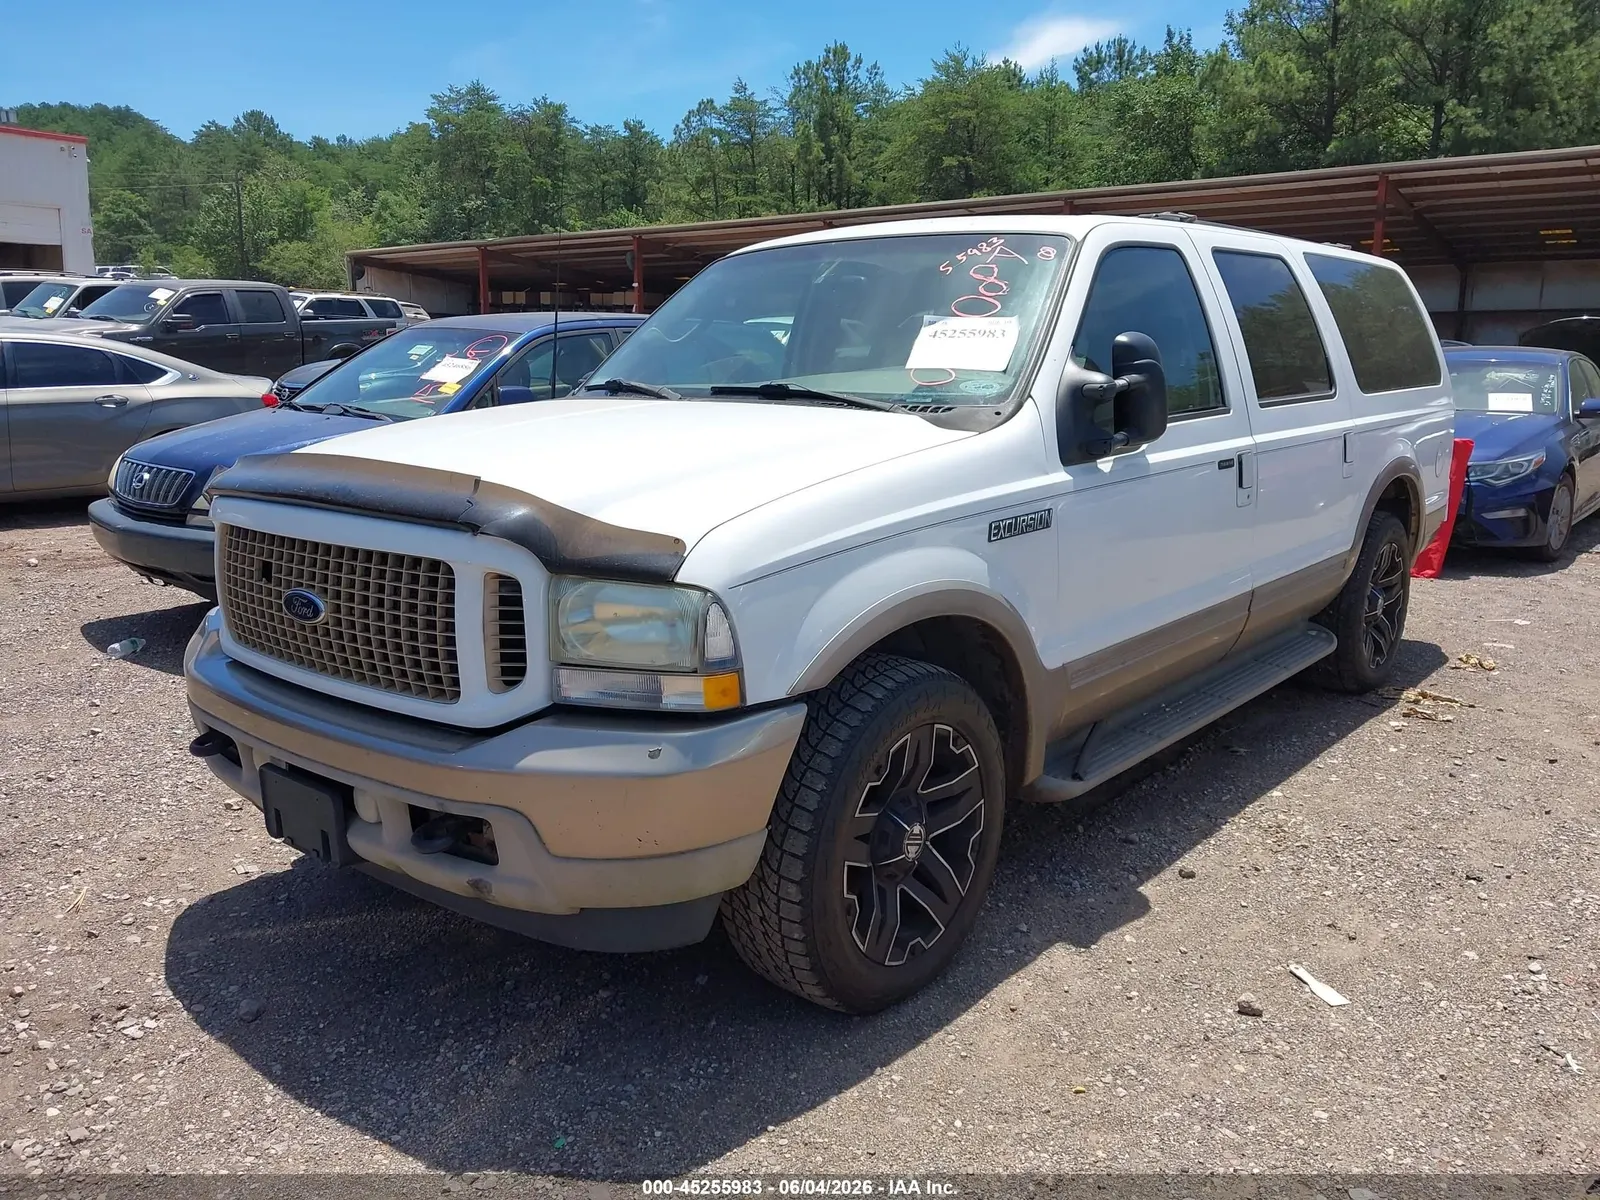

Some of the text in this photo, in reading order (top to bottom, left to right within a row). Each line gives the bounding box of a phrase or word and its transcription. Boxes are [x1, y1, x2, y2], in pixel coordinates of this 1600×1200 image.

[928, 328, 1007, 339] 45255983
[990, 509, 1054, 541] EXCURSION
[290, 596, 314, 618] Ford
